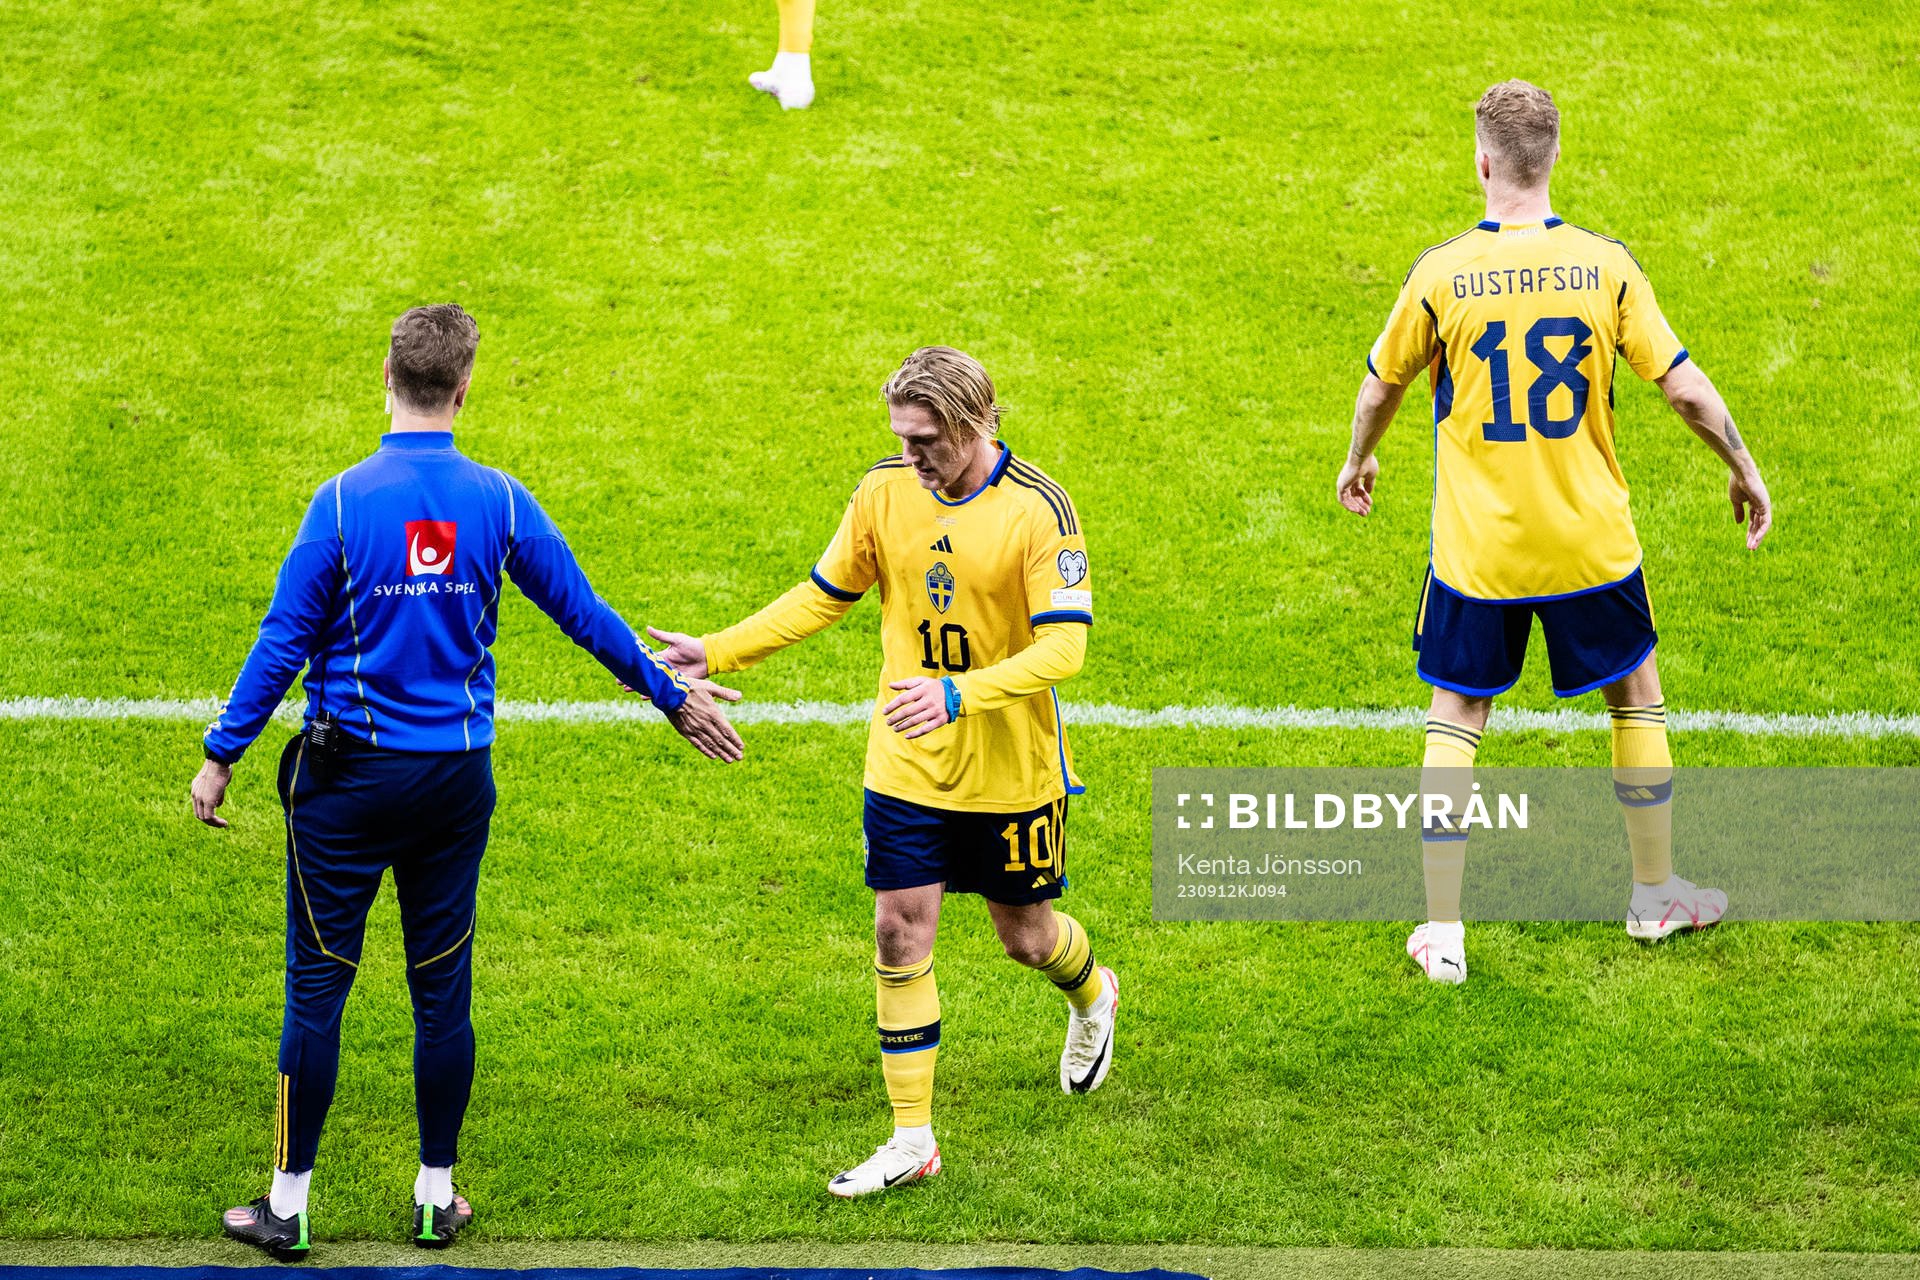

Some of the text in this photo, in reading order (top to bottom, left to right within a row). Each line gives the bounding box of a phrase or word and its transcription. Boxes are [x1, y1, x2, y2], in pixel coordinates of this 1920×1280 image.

[1453, 266, 1599, 299] GUSTAFSON
[1470, 317, 1593, 441] 18
[373, 582, 476, 596] SVENSKA SPEL
[917, 619, 971, 672] 10
[1001, 815, 1053, 871] 10
